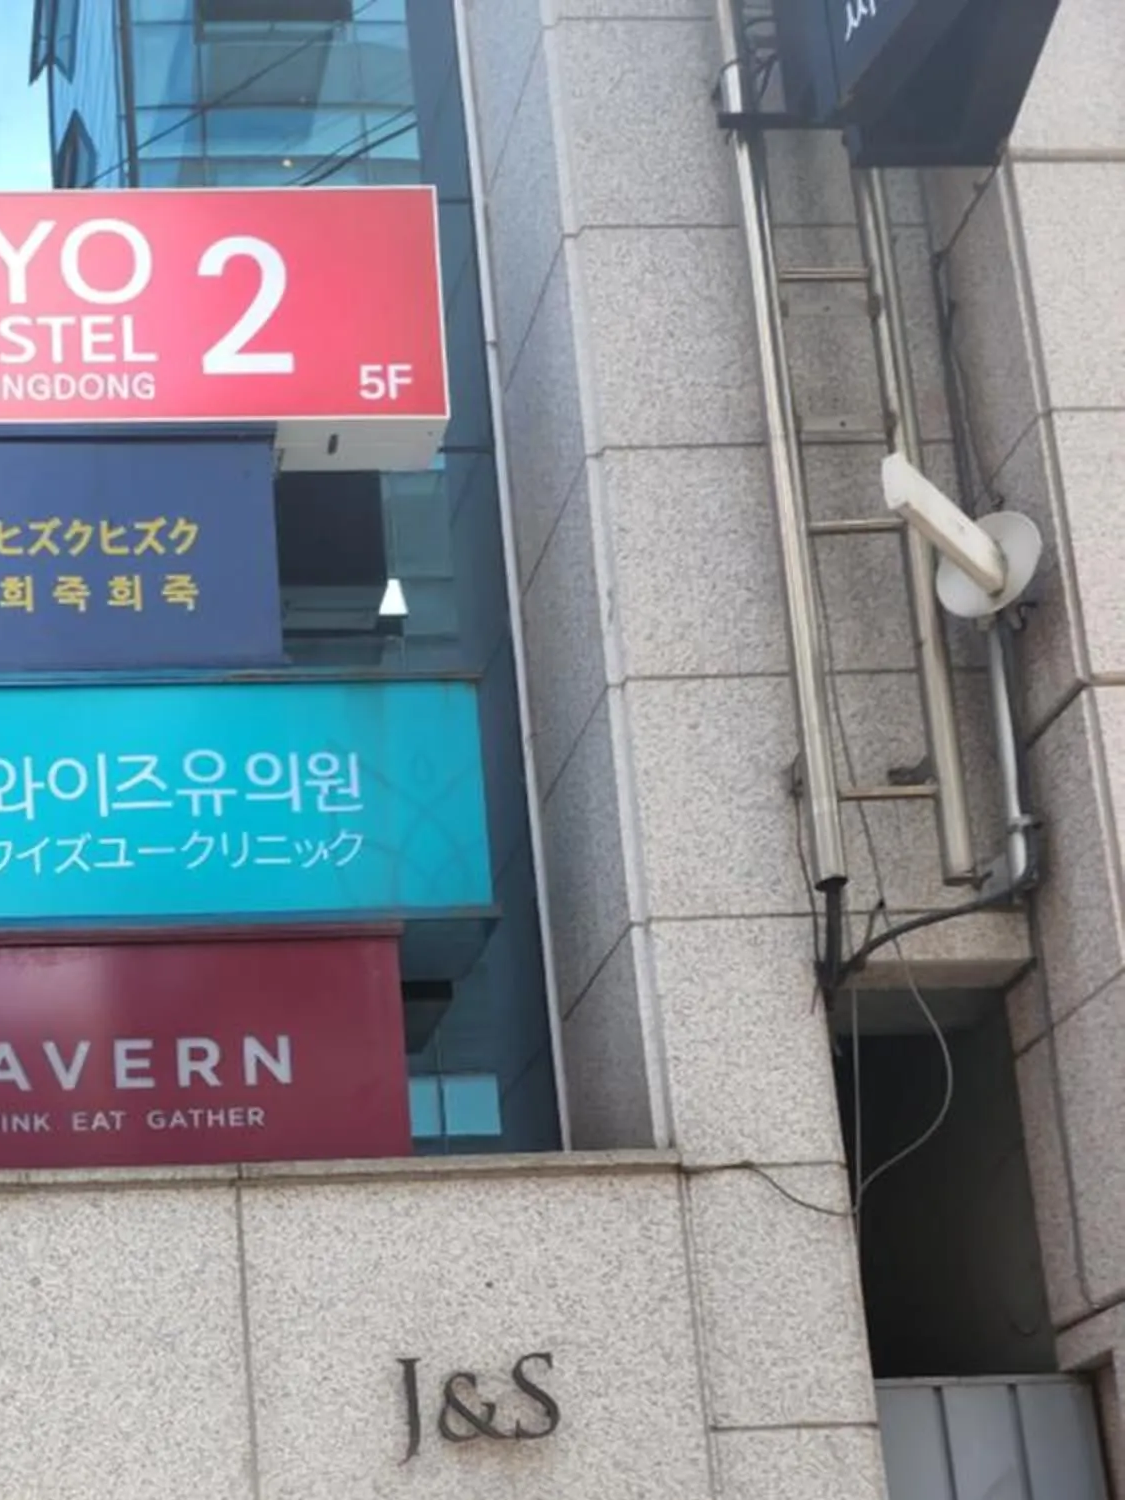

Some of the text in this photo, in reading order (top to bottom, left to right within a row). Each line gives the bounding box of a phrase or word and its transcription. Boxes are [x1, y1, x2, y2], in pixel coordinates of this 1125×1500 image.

[197, 235, 294, 375] 2
[359, 364, 414, 400] 5F
[72, 1109, 125, 1132] EAT
[147, 1106, 266, 1131] GATHER
[394, 1352, 561, 1468] J&S
